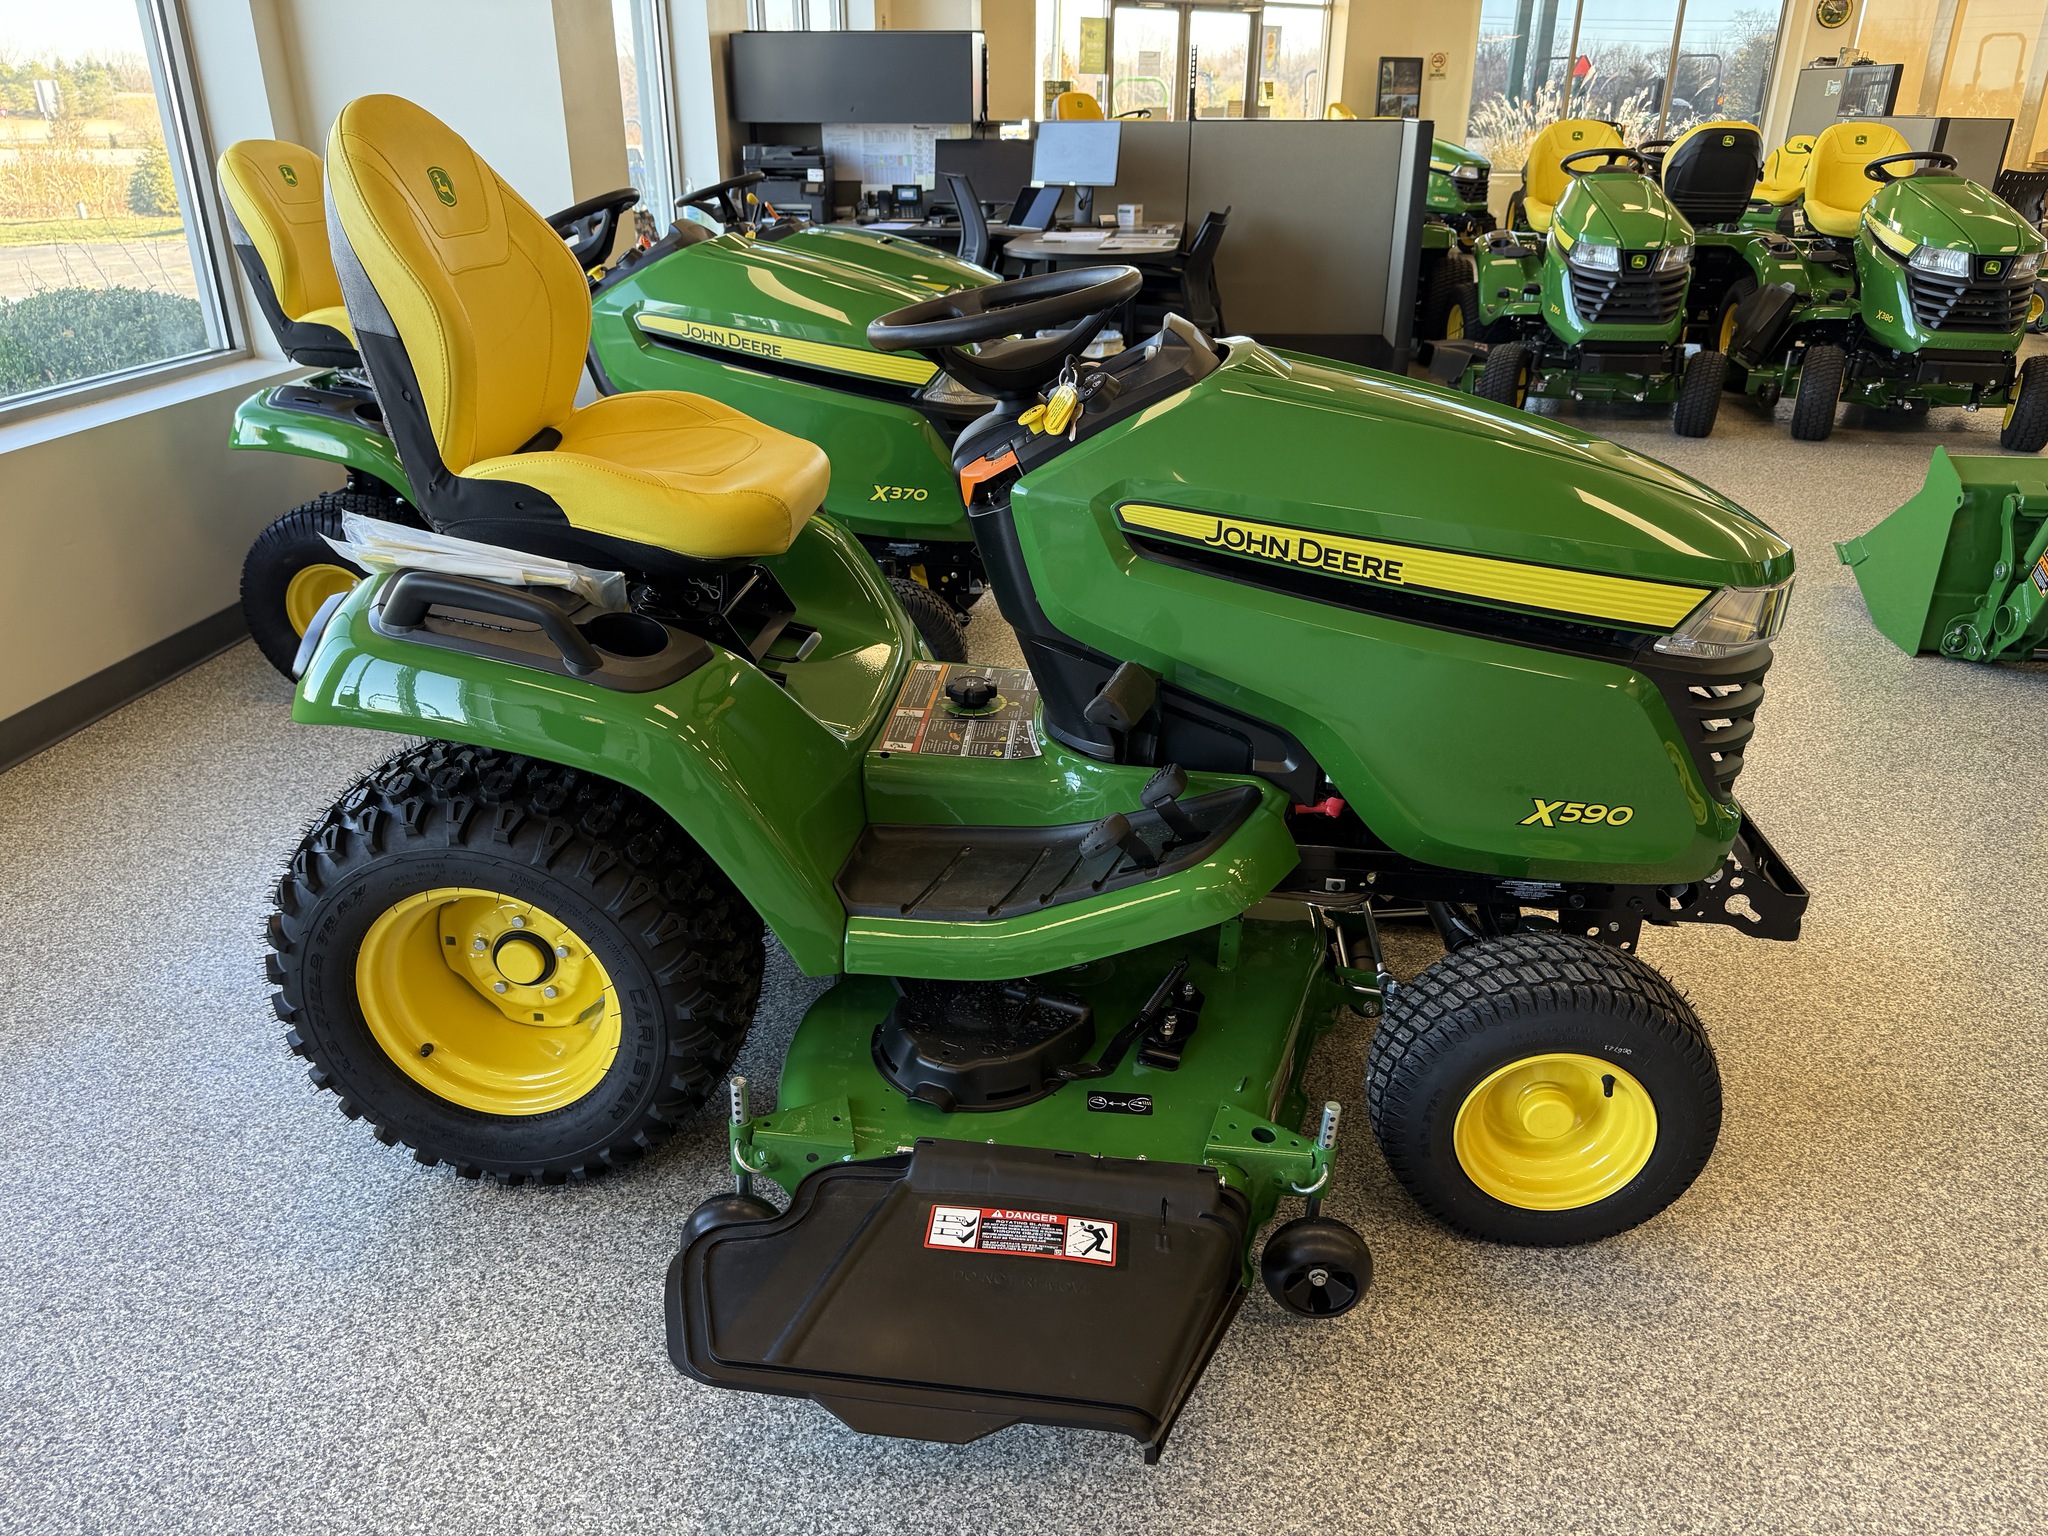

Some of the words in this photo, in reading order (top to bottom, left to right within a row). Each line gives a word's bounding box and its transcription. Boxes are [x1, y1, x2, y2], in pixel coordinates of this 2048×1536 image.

[1876, 309, 1894, 323] X380
[682, 323, 724, 344] JOHN
[729, 332, 782, 357] DEERE
[869, 484, 929, 503] X370
[1205, 520, 1290, 559] JOHN
[1298, 538, 1403, 582] DEERE
[1518, 798, 1635, 828] X590
[608, 988, 655, 1121] CARLSTAR
[1006, 1211, 1057, 1223] DANGER
